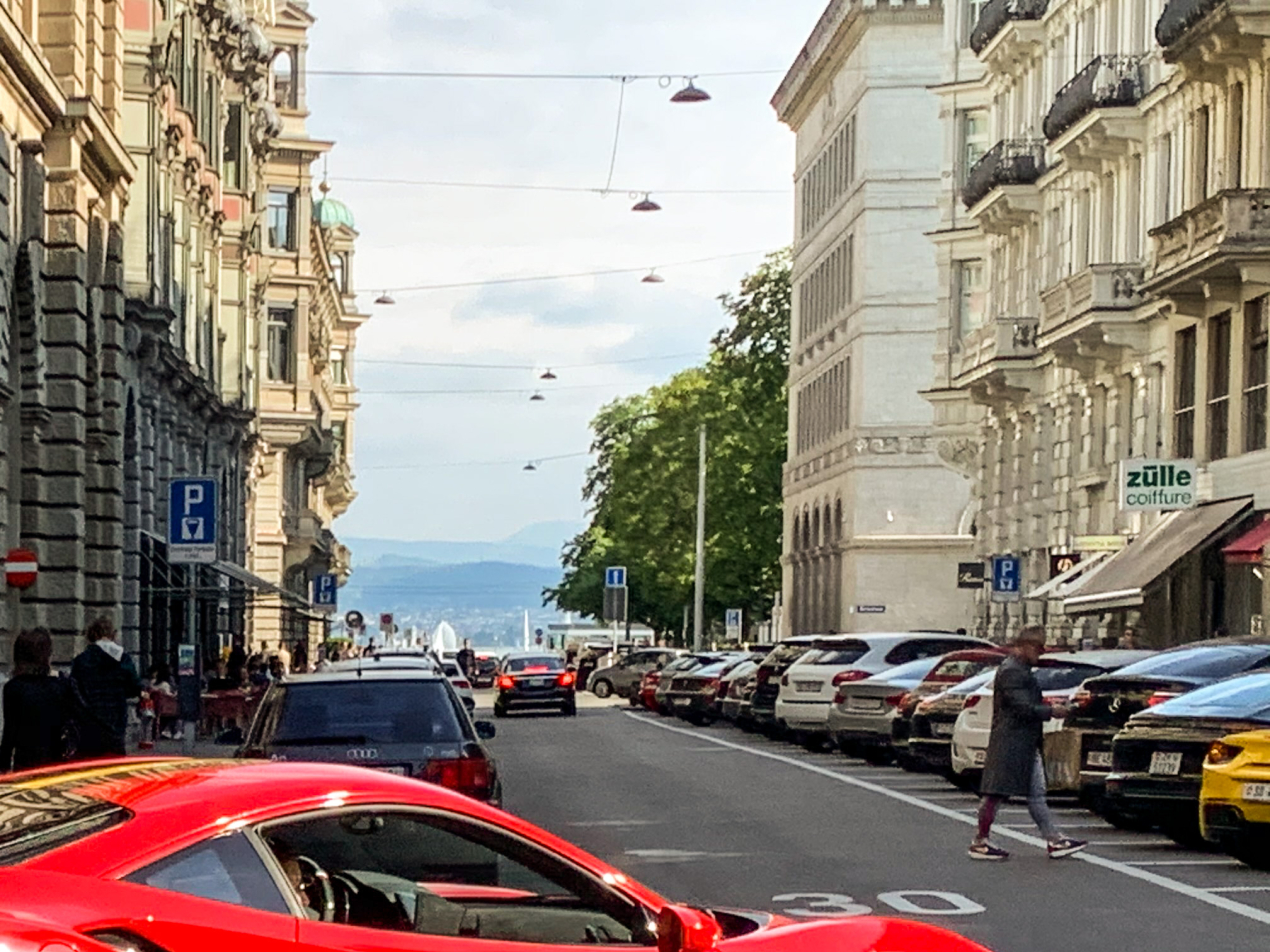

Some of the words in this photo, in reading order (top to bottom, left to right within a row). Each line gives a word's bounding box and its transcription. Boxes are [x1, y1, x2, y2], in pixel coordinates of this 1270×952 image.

[184, 484, 204, 515] P
[1126, 488, 1192, 505] coiffure
[1002, 560, 1013, 577] P
[772, 890, 987, 917] 30
